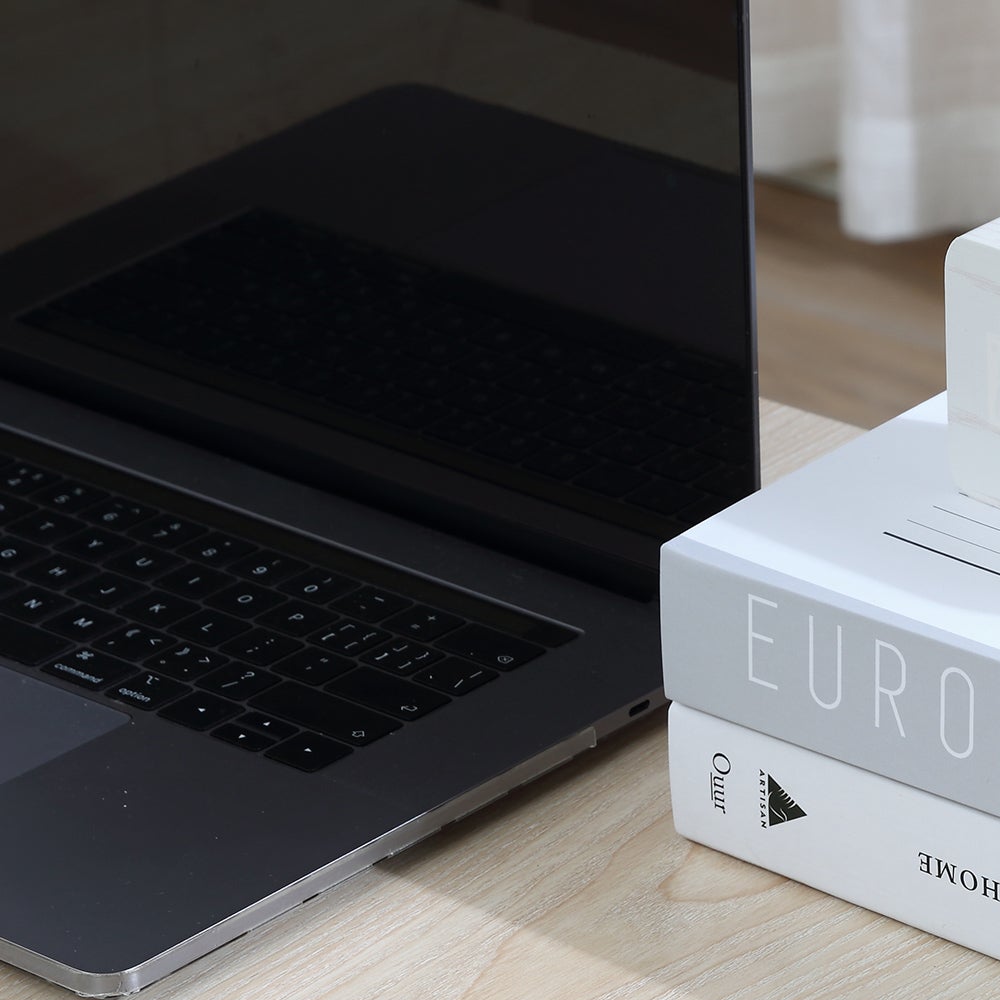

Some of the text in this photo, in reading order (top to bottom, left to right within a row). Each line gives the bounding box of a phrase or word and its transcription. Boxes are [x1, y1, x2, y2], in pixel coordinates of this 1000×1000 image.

[53, 663, 104, 684] command
[118, 687, 151, 703] option
[759, 768, 768, 829] ARTISAN
[917, 851, 1000, 902] HOME
